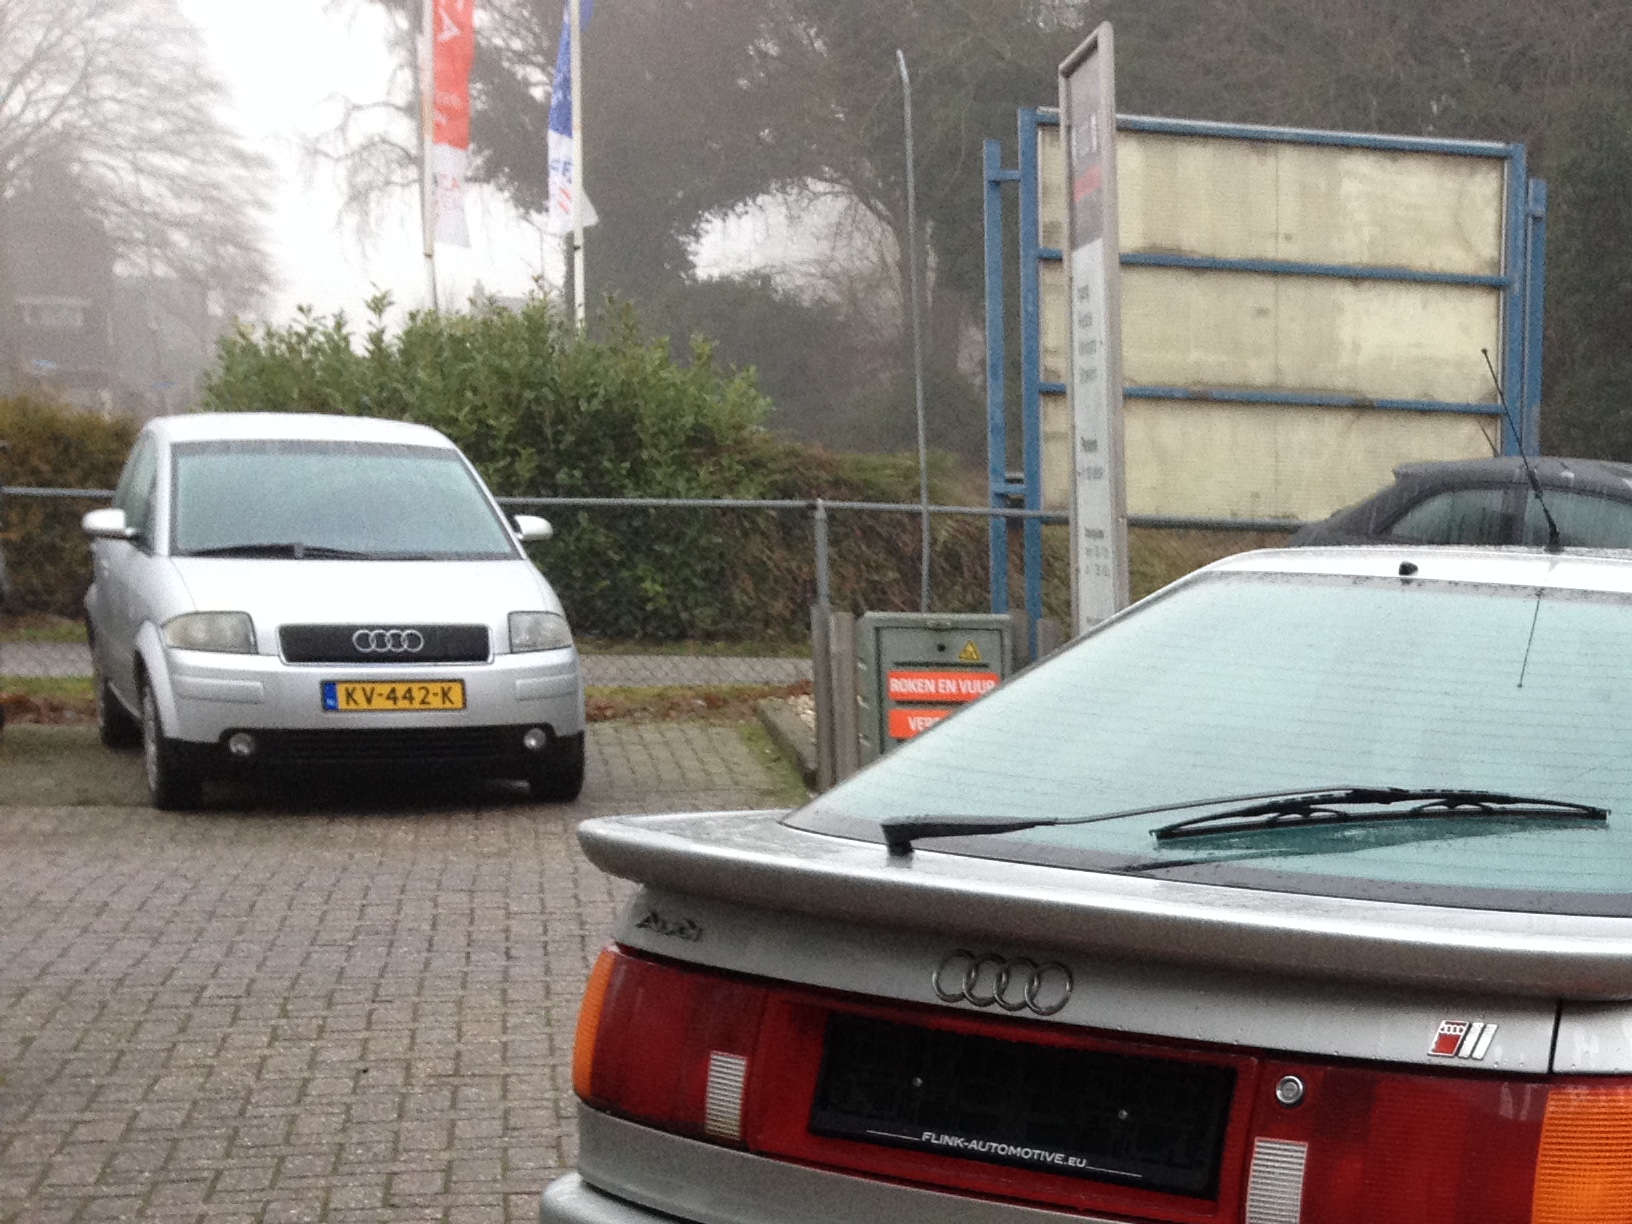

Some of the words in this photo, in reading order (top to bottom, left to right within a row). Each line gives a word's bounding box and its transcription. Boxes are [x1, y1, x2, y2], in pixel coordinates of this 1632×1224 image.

[344, 685, 455, 706] KV-442-K
[889, 678, 936, 693] ROKEN
[938, 679, 957, 693] EN
[921, 1131, 1087, 1168] FLINK-AUTOMOTIVE.EU
